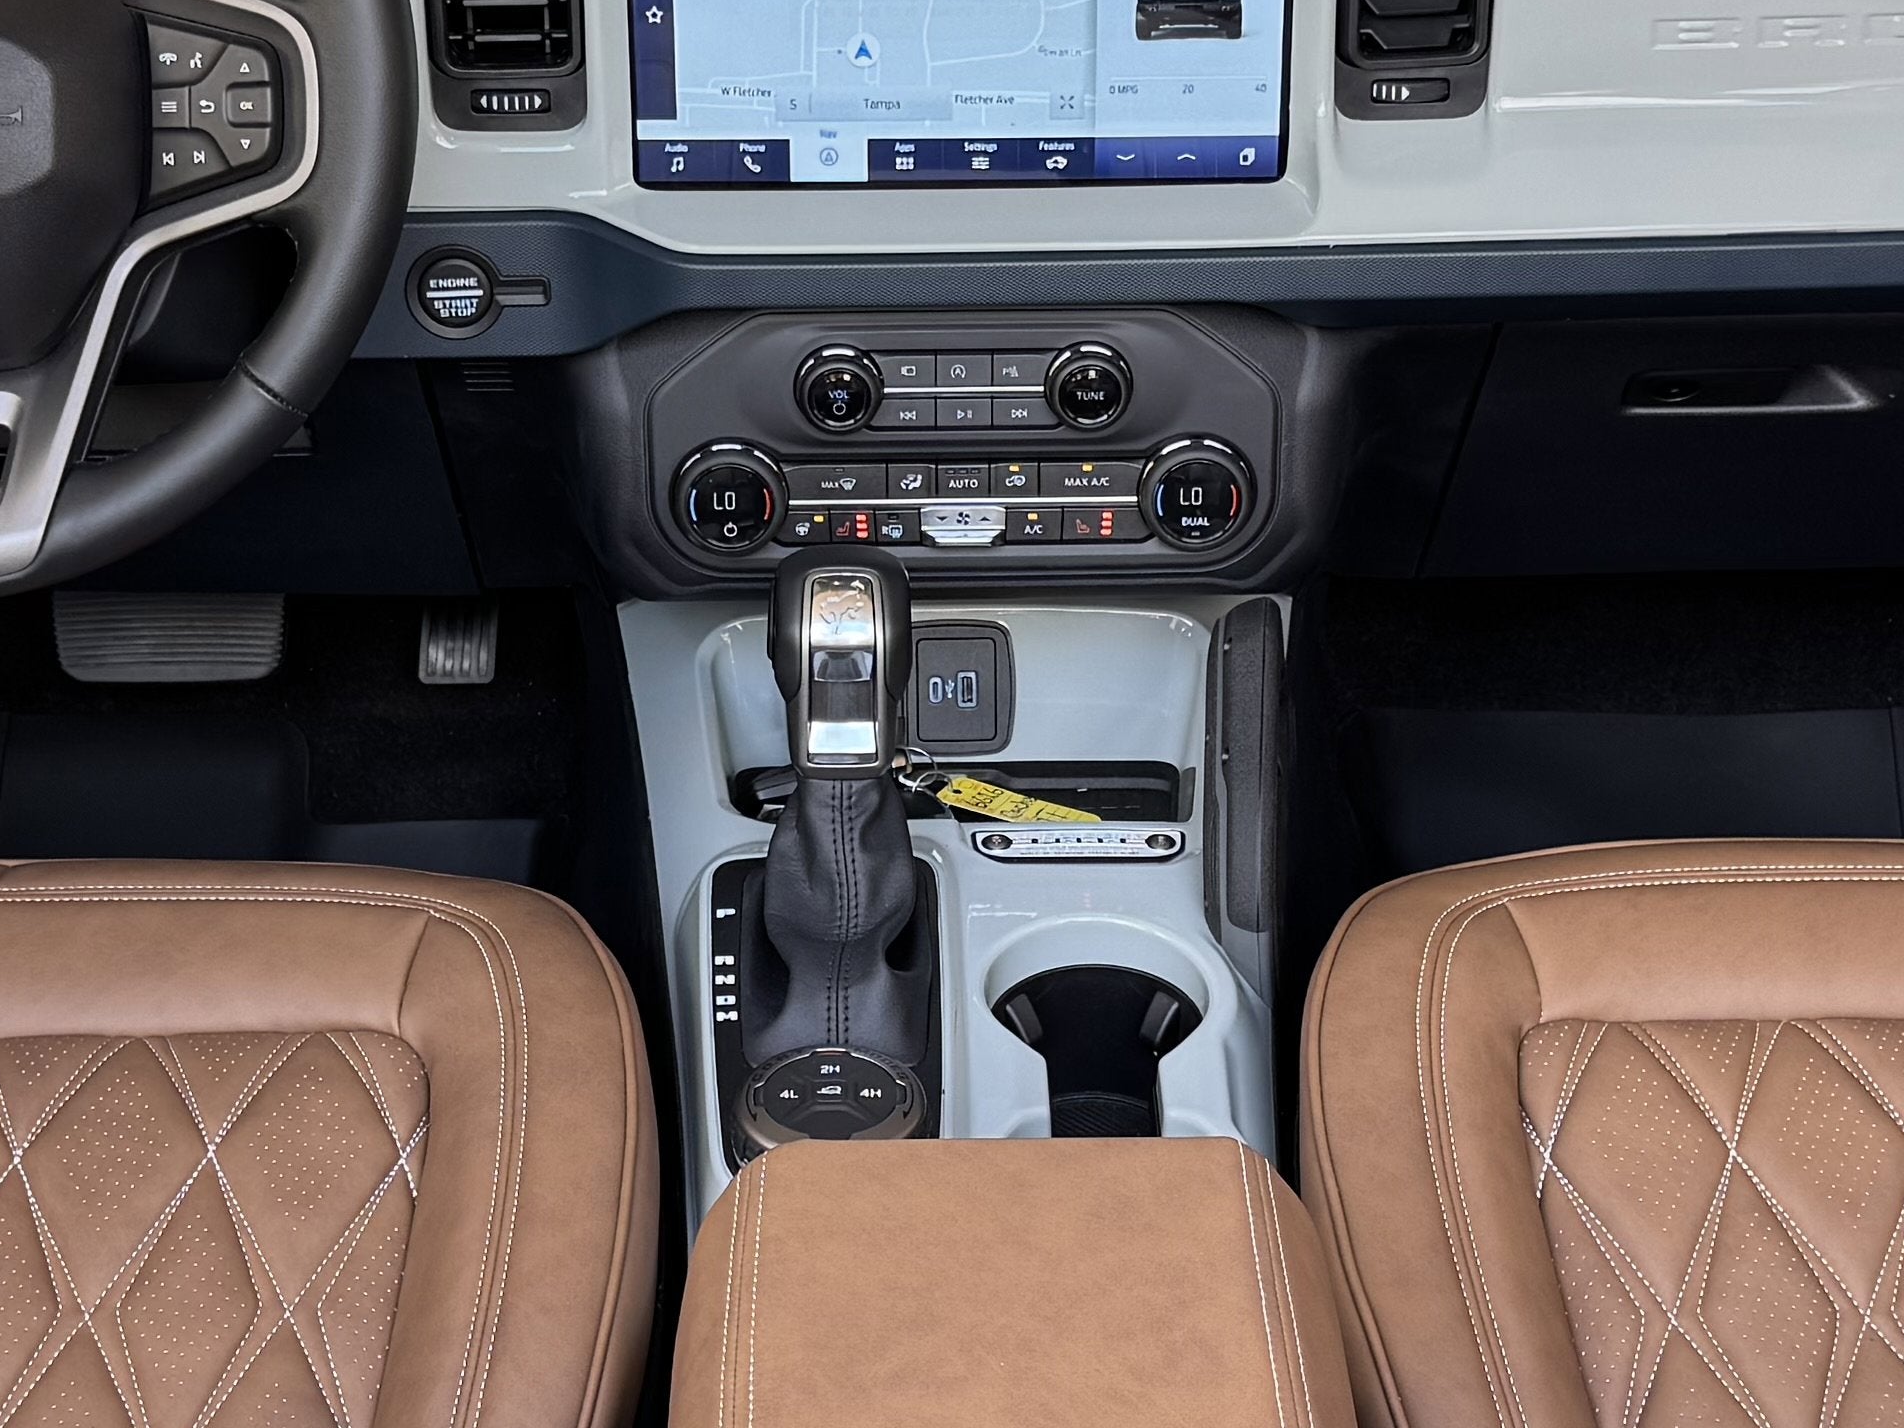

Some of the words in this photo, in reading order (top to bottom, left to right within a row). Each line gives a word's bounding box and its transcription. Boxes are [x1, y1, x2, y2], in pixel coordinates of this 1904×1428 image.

[720, 87, 731, 96] W
[733, 86, 772, 98] Fletcher
[1117, 85, 1139, 94] MPG
[1182, 84, 1194, 94] 20
[1255, 83, 1267, 93] 40
[239, 101, 254, 110] OK
[789, 99, 797, 110] S
[864, 98, 901, 111] Tampa
[954, 95, 994, 105] Fletcher
[996, 95, 1015, 105] Ave
[664, 143, 689, 153] Audio
[739, 143, 766, 153] Phone
[894, 142, 915, 152] Apps
[964, 141, 998, 153] Settings
[1038, 141, 1076, 151] Features
[429, 277, 478, 289] ENGINE
[434, 298, 479, 309] START
[440, 308, 477, 318] STOP
[828, 390, 850, 399] VOL
[1077, 391, 1105, 401] TUNE
[948, 478, 979, 489] AUTO
[1064, 476, 1089, 487] MAX
[1091, 476, 1110, 487] A/C
[713, 491, 736, 511] LO
[1179, 486, 1203, 505] LO
[1181, 516, 1210, 527] DUAL
[1024, 524, 1043, 535] A/C
[819, 1065, 841, 1074] 2H
[779, 1089, 799, 1099] 4L
[859, 1088, 882, 1099] 4H
